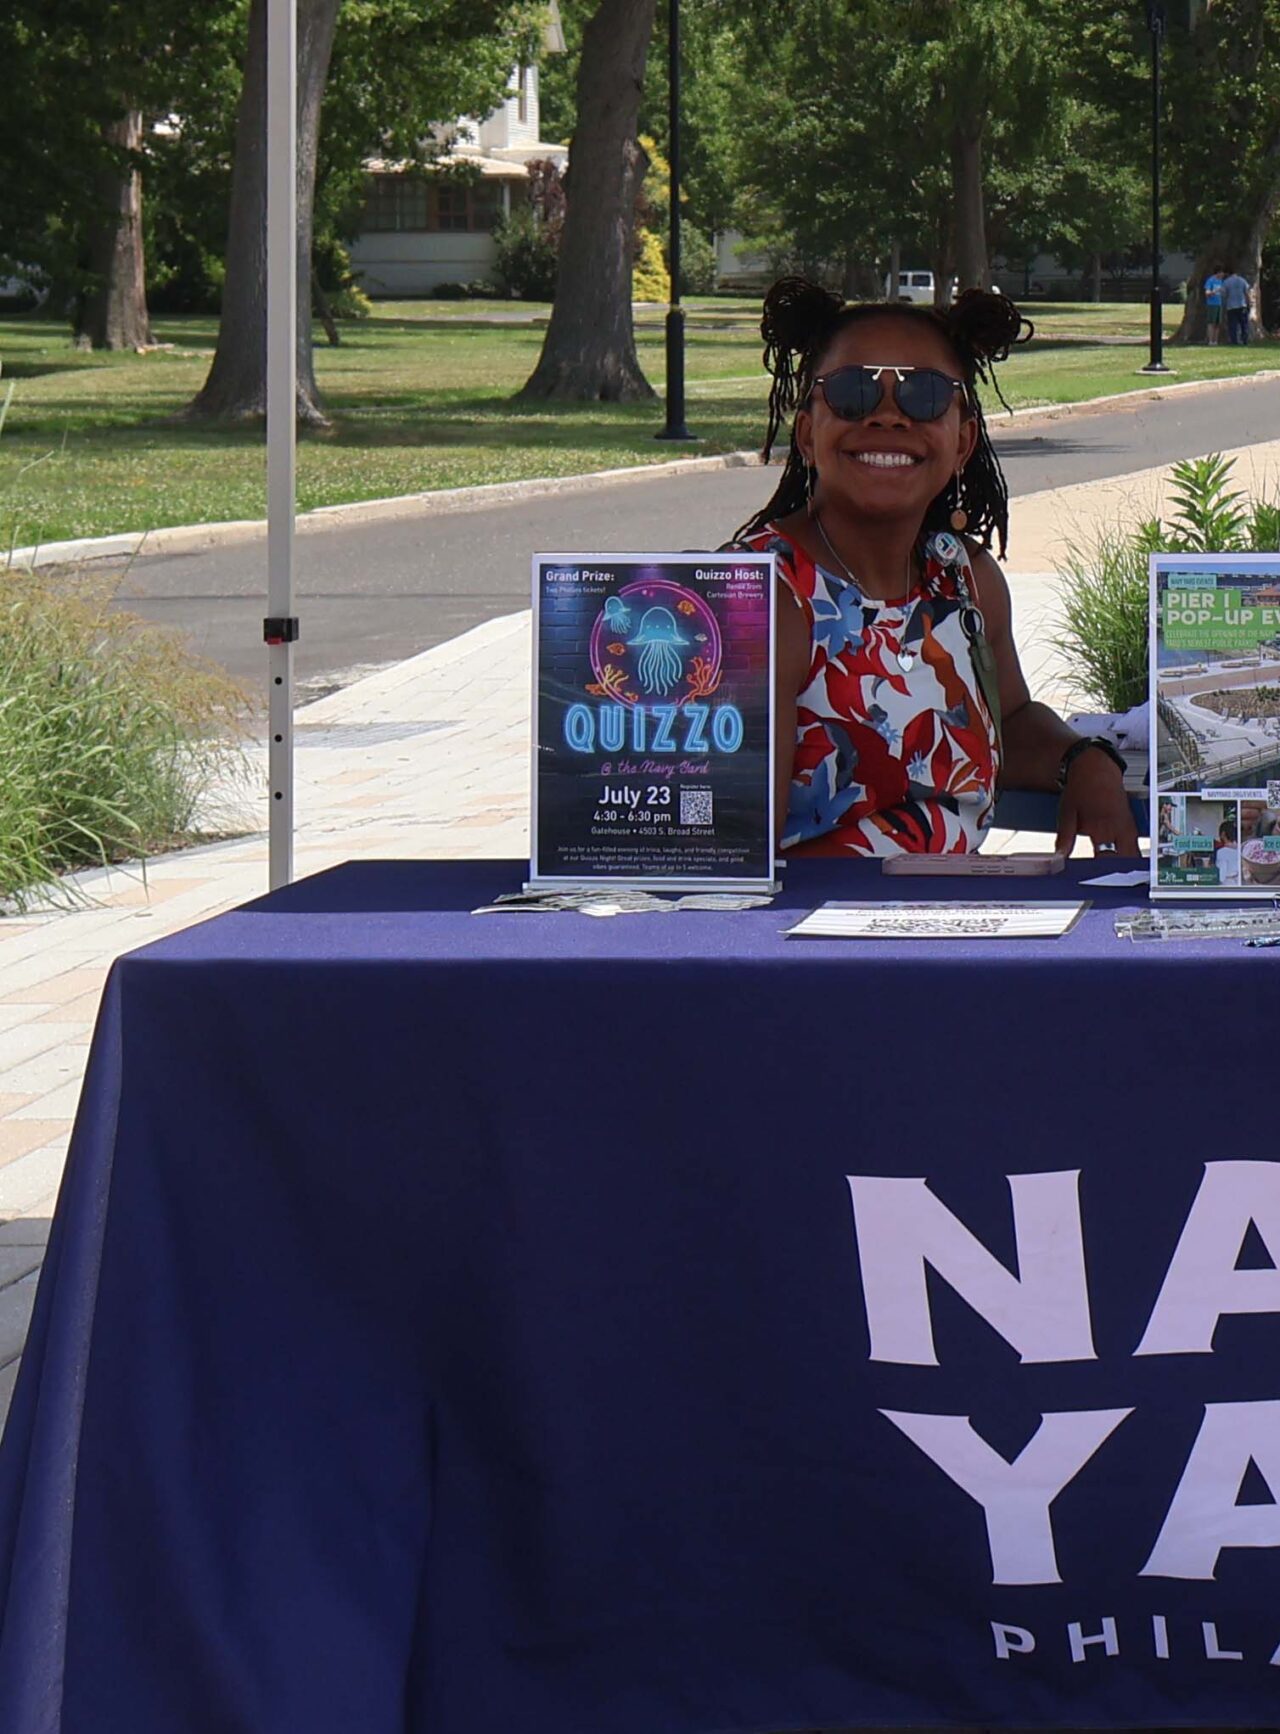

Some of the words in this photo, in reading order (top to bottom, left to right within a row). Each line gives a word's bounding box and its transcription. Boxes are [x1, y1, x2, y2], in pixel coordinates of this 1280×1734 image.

[546, 571, 579, 582] Grand
[582, 571, 615, 582] Prize:
[695, 569, 732, 580] Quizzo
[735, 569, 764, 580] Host:
[1167, 592, 1215, 609] PIER
[1167, 609, 1253, 625] POP-UP
[565, 704, 743, 753] QUIZZO
[618, 760, 637, 774] the
[640, 760, 675, 780] Navy
[680, 760, 710, 775] Yard
[598, 786, 641, 809] July
[646, 786, 671, 805] 23
[593, 811, 617, 822] 4:30
[627, 811, 651, 822] 6:30
[653, 813, 671, 824] pm
[591, 826, 630, 836] Gatehouse
[638, 826, 657, 836] 4503
[667, 826, 690, 836] Broad
[691, 826, 715, 836] Street
